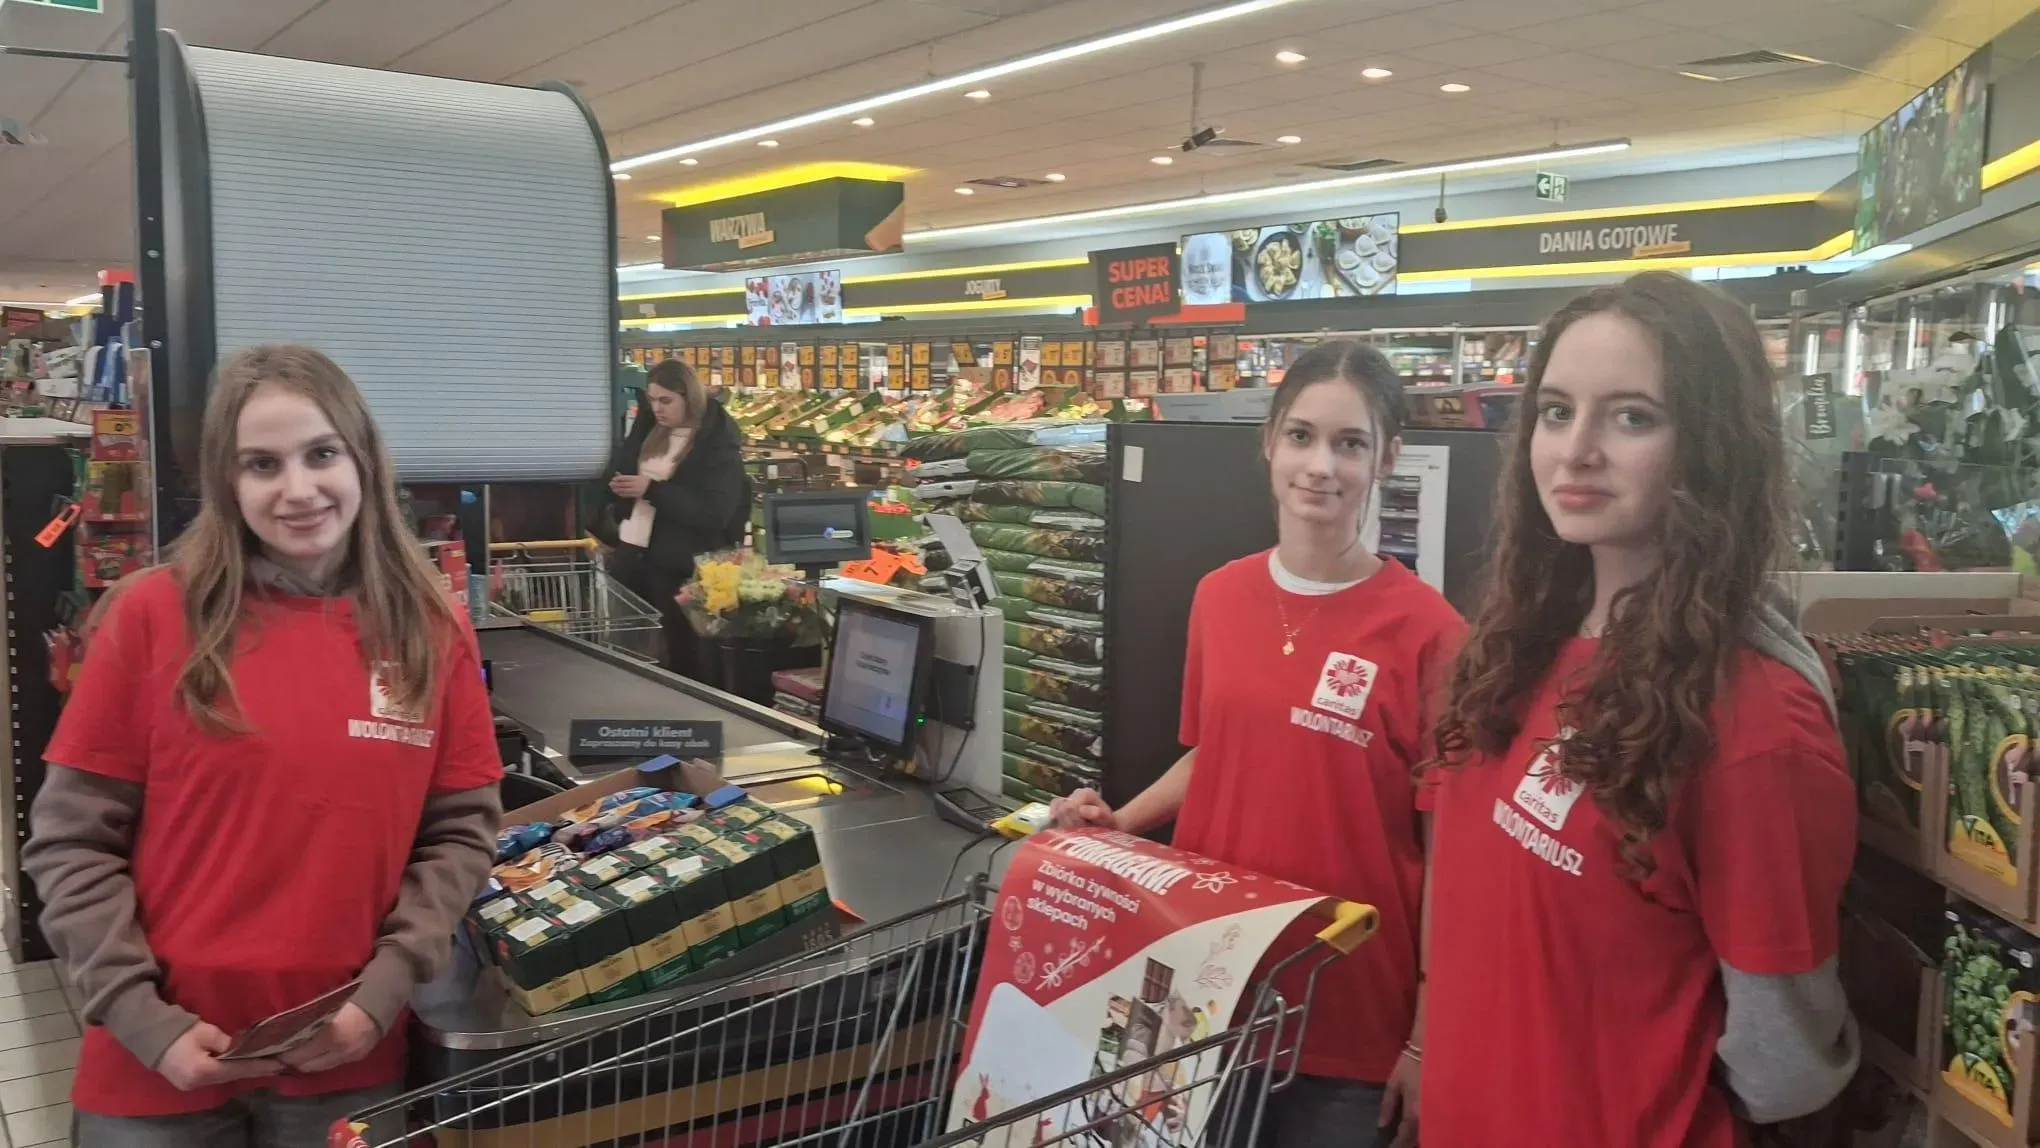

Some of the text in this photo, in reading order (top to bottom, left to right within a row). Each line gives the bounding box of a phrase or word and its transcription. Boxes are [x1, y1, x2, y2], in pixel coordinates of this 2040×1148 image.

[1539, 230, 1594, 253] DANIA
[1598, 223, 1678, 250] GOTOWE
[1108, 256, 1170, 283] SUPER
[1111, 281, 1170, 310] CENA!
[1317, 697, 1357, 716] caritas
[598, 726, 693, 738] Ostatni klient
[1290, 706, 1375, 748] WOLONTARIUSZ
[643, 738, 656, 748] do
[1519, 790, 1559, 823] caritas
[1492, 798, 1584, 876] WOLONTARIUSZ
[1032, 879, 1117, 923] w wybranych
[1038, 860, 1140, 914] Zbiórka żywności
[1026, 896, 1089, 931] sklepach
